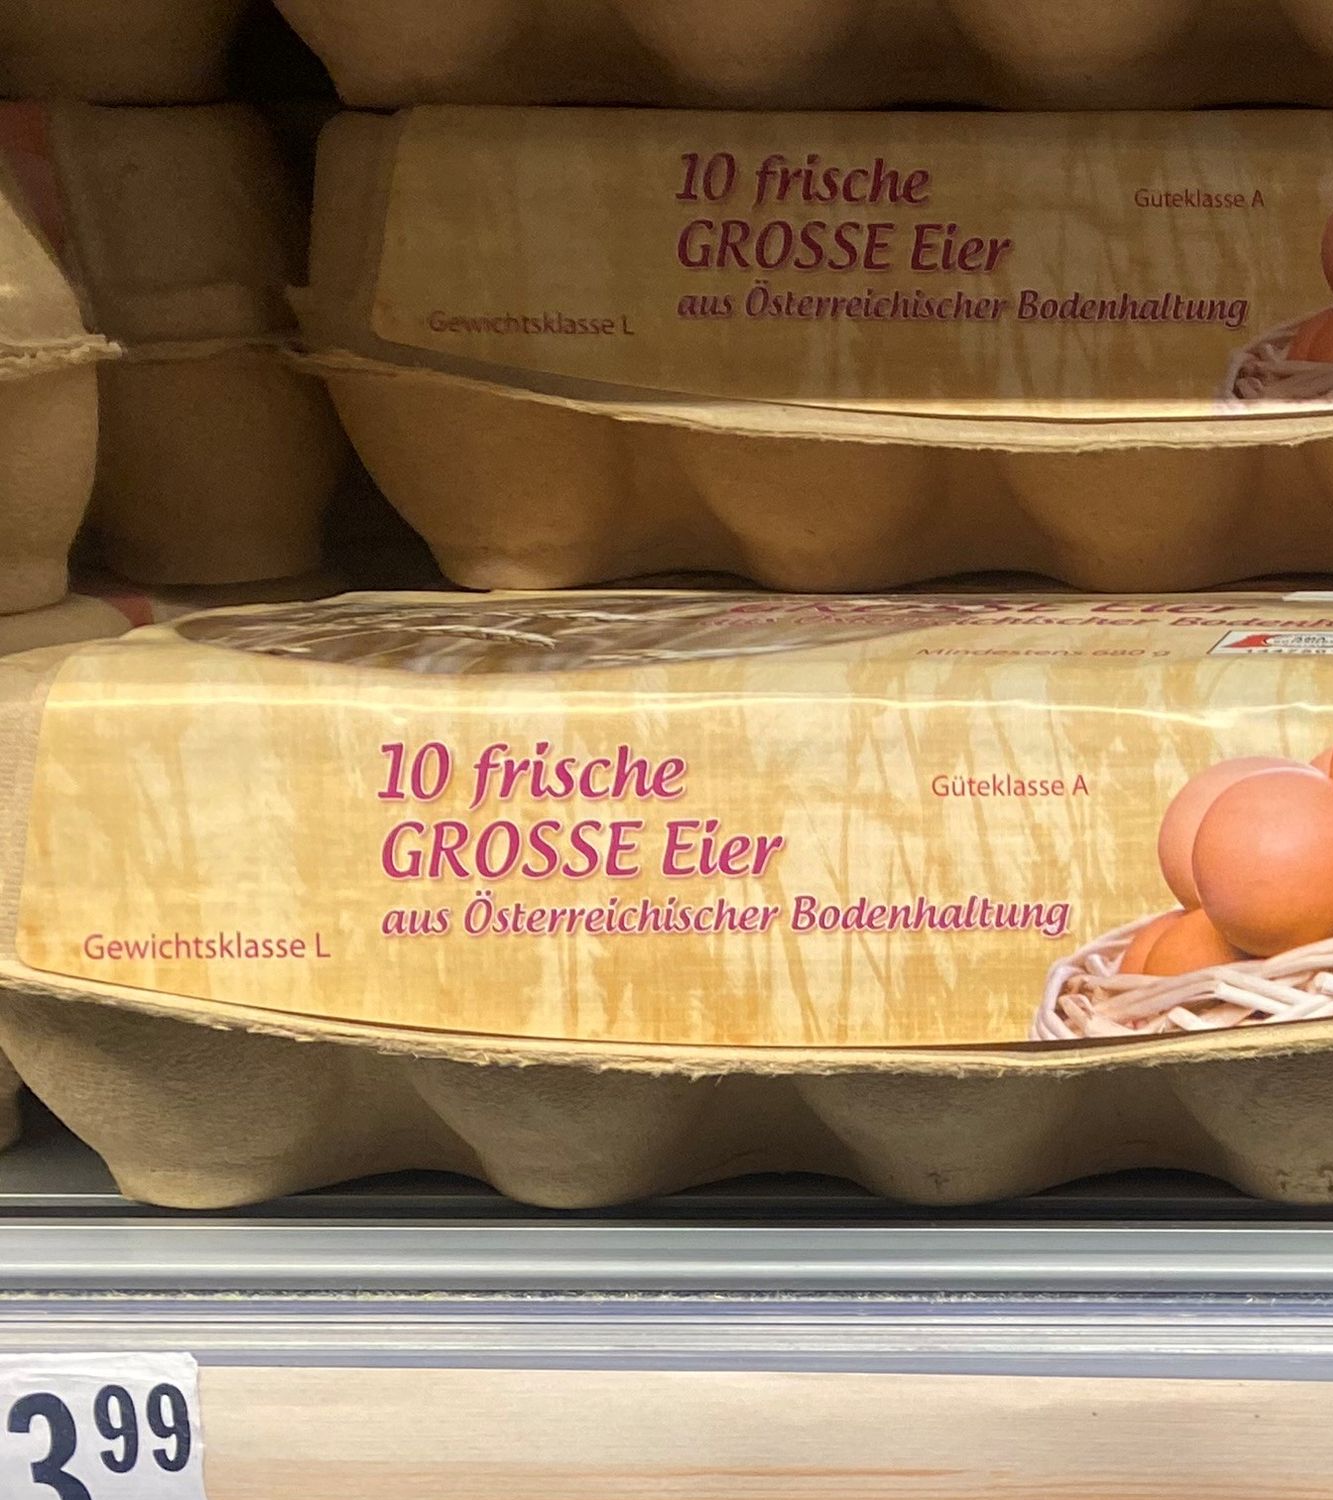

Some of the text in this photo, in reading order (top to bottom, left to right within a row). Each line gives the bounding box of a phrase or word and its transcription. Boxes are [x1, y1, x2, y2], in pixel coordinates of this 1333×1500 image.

[676, 152, 929, 210] 10 frische
[677, 220, 1013, 272] GROSSE Eier
[677, 279, 1249, 329] aus Österreichischer Bodenhaltung
[378, 741, 686, 810] 10 frische
[931, 773, 1066, 799] Güteklasse
[381, 818, 782, 880] GROSSE Eier
[381, 890, 1069, 938] aus Österreichischer Bodenhaltung
[84, 931, 331, 963] Gewichtsklasse L
